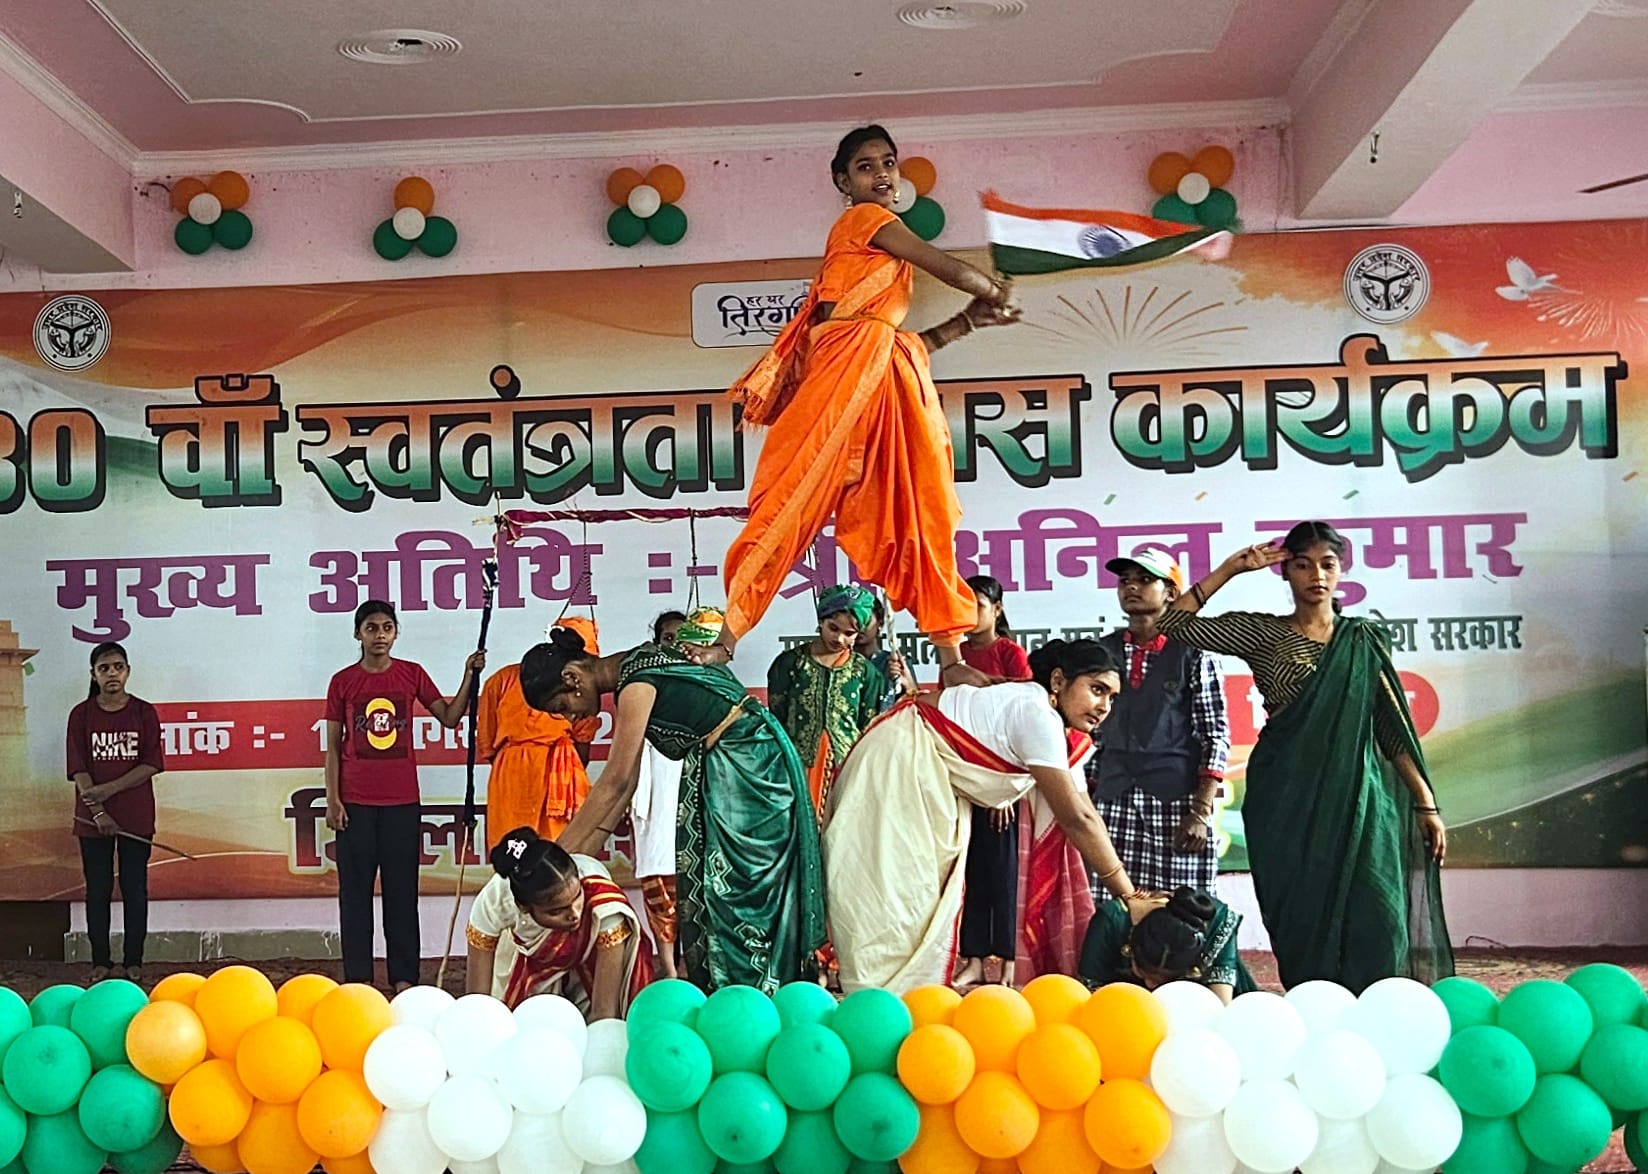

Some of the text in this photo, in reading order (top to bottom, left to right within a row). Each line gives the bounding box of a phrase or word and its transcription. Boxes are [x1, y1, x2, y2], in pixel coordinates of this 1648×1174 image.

[1109, 333, 1628, 482] कार्यक्रम
[46, 554, 270, 644] मुख्य
[309, 526, 603, 613] अतिथि
[953, 508, 1223, 592] अनिल
[1427, 616, 1523, 651] सरकार
[91, 731, 139, 758] NIKE
